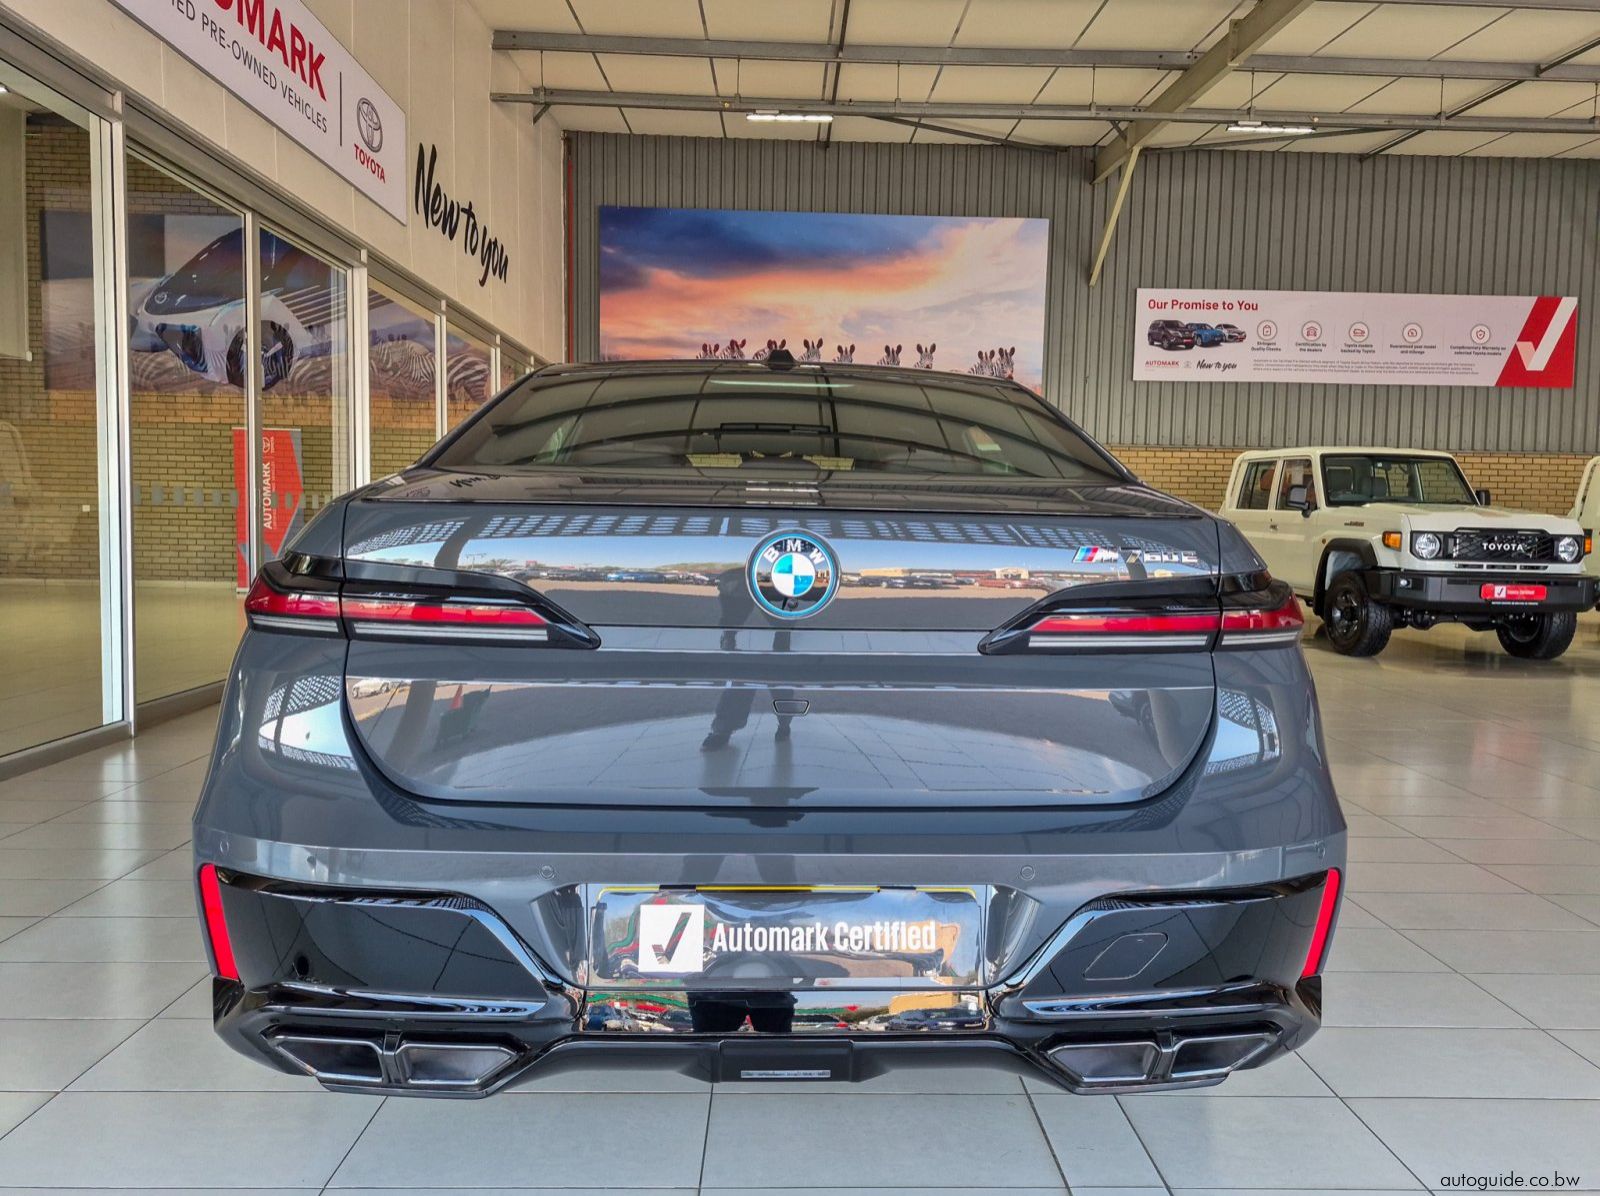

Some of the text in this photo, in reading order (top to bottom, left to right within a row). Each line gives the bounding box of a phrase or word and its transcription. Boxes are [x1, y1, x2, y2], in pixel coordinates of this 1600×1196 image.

[201, 13, 277, 90] PRE-OWNED
[280, 80, 328, 134] VEHICLES
[354, 143, 386, 184] TOYOTA
[414, 142, 509, 287] New to you
[1148, 299, 1259, 311] Our Promise to You
[1197, 359, 1237, 372] New to you
[262, 462, 272, 530] AUTOMARK
[763, 539, 825, 564] BMW
[1482, 542, 1523, 551] TOYOTA
[712, 920, 936, 952] Automark Certified
